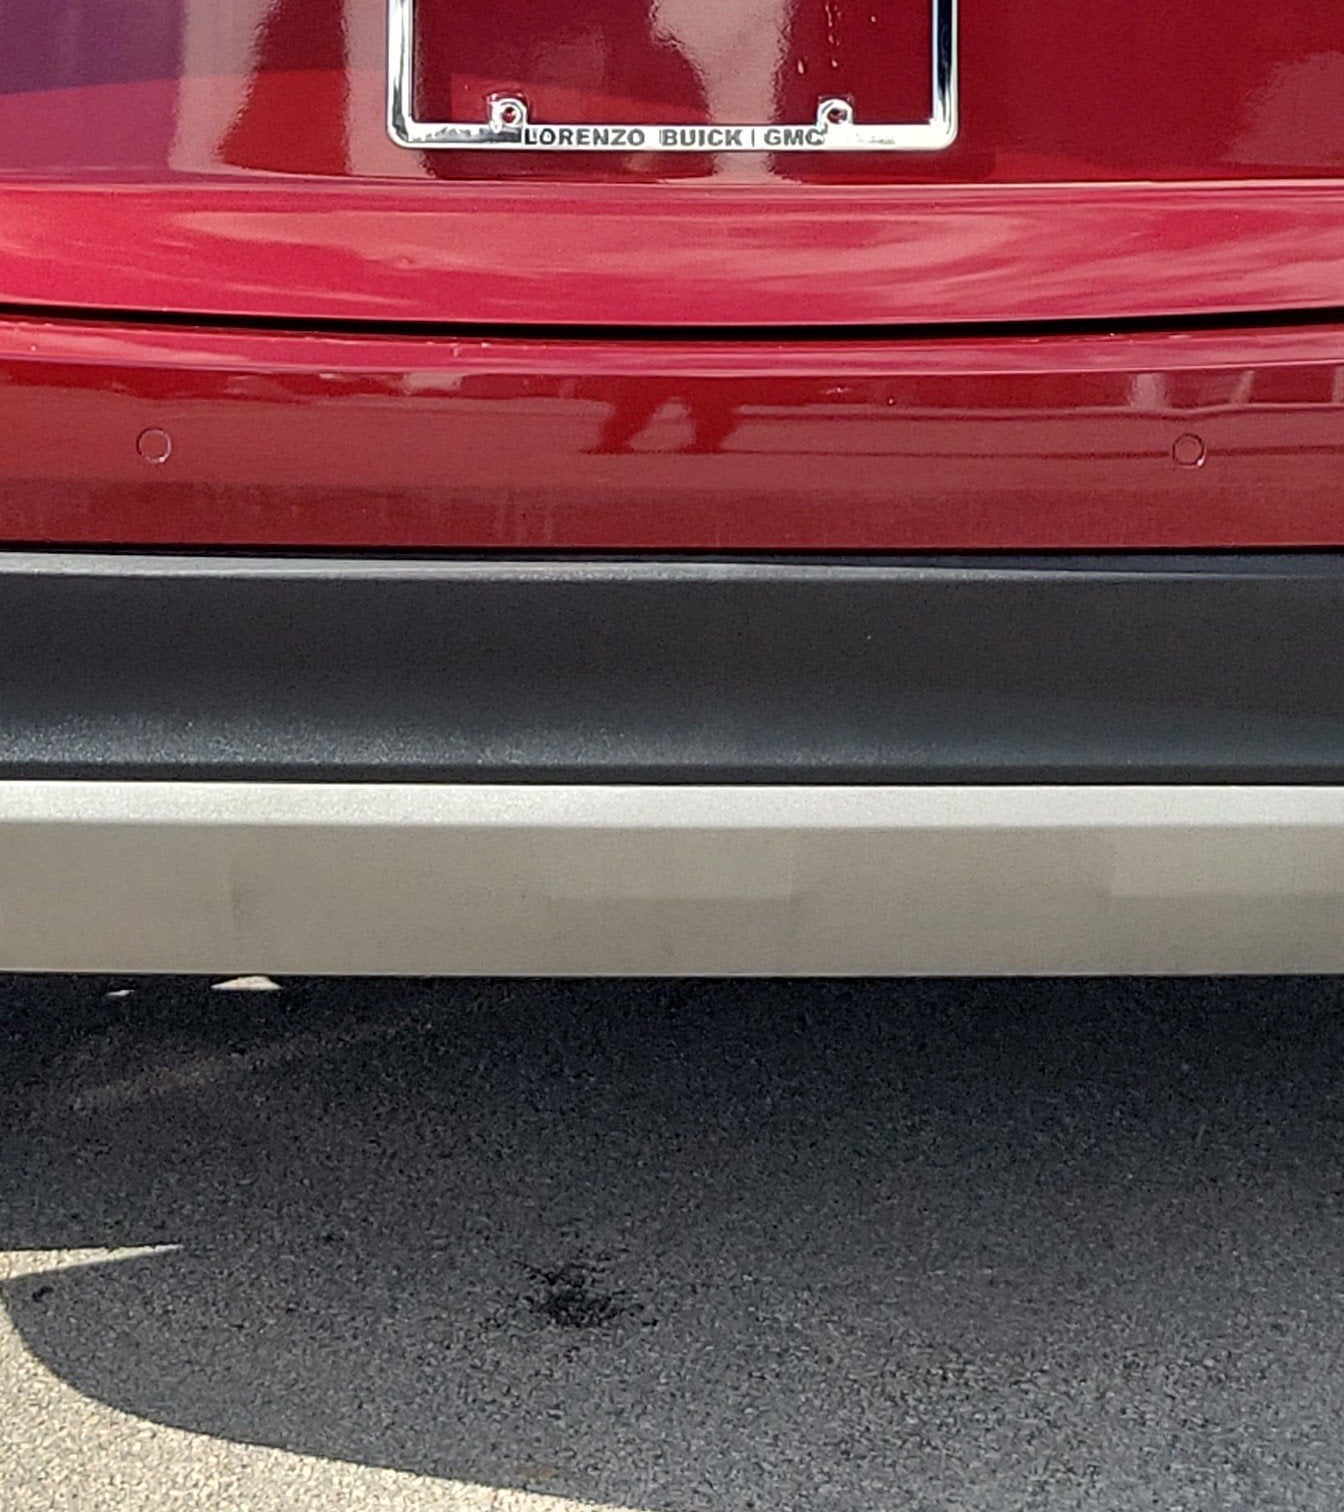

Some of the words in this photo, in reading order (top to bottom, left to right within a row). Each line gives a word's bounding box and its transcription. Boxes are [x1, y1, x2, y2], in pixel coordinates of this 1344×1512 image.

[524, 126, 646, 147] LORENZO
[660, 127, 744, 147] BUICK
[763, 126, 825, 147] GMC
